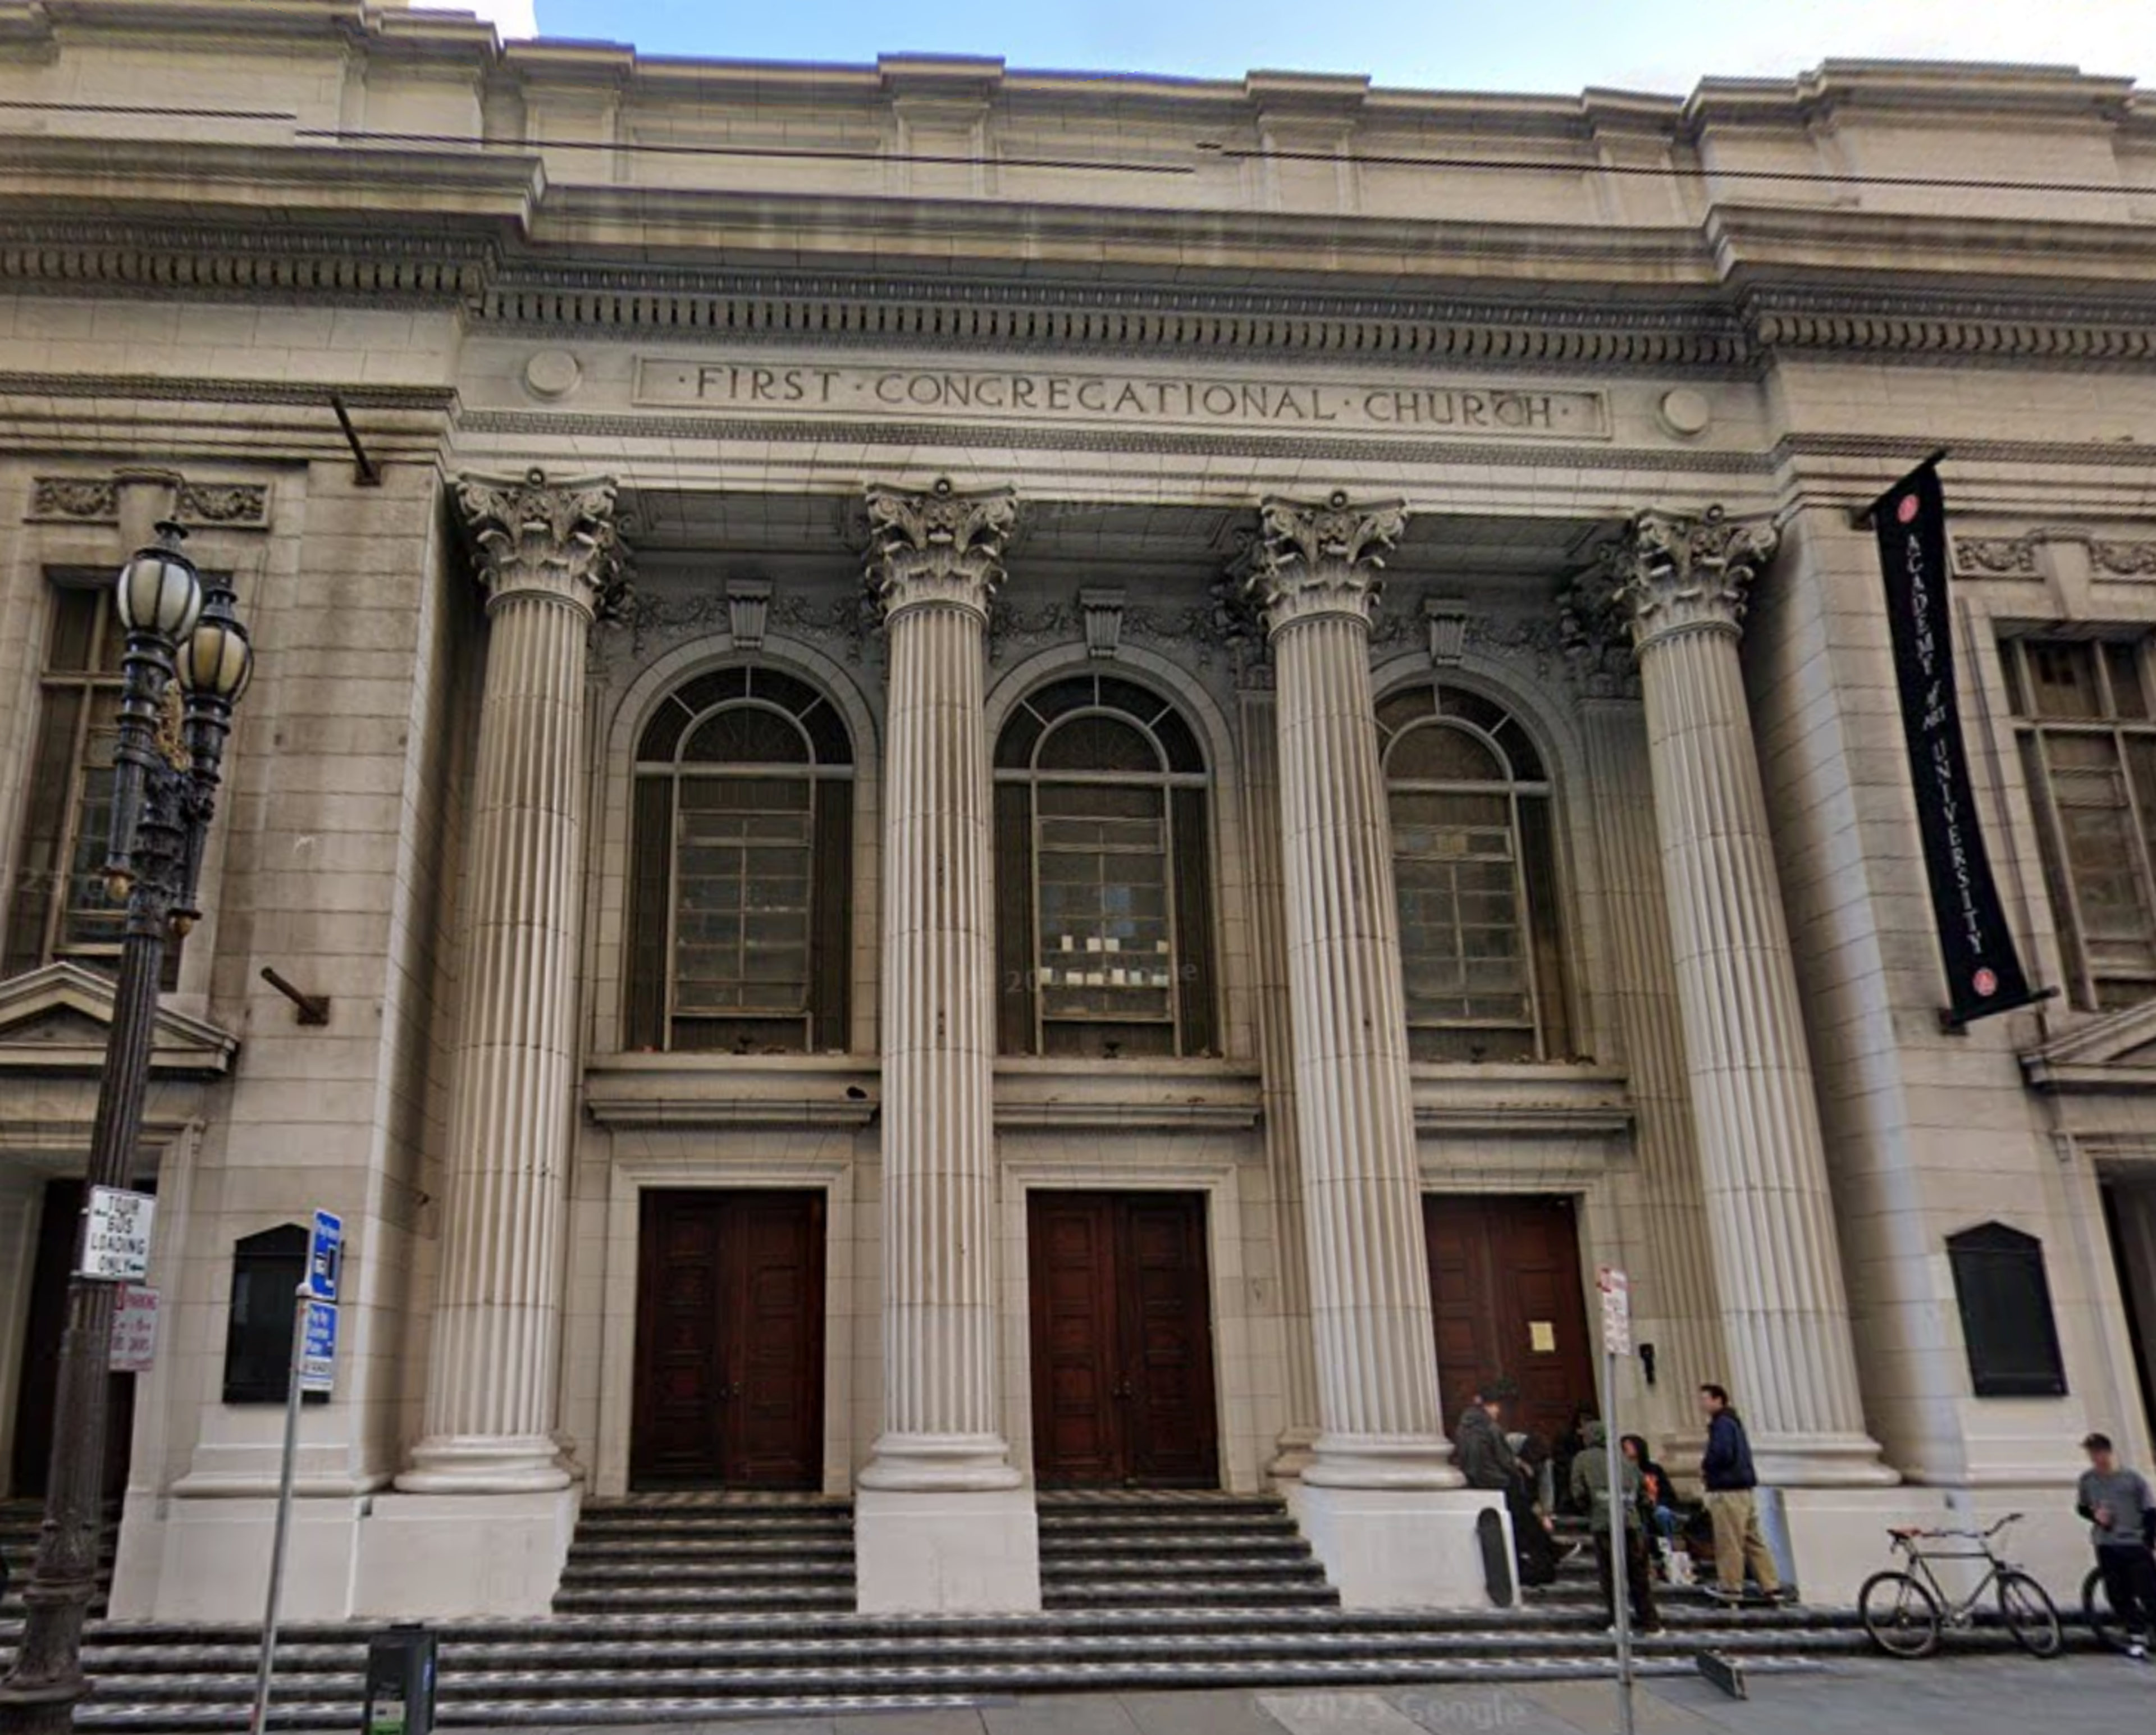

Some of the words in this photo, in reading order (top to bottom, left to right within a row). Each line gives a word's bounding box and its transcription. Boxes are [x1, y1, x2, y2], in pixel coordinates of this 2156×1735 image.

[696, 366, 841, 402] FIRST
[874, 372, 1337, 421] CONGREGATIONAL
[1363, 391, 1552, 428] CHURCH
[1906, 533, 1935, 675] ACADEMY
[1930, 739, 1982, 954] UNIVERSITY
[90, 1233, 145, 1255] LOADING
[107, 1215, 134, 1235] BUS
